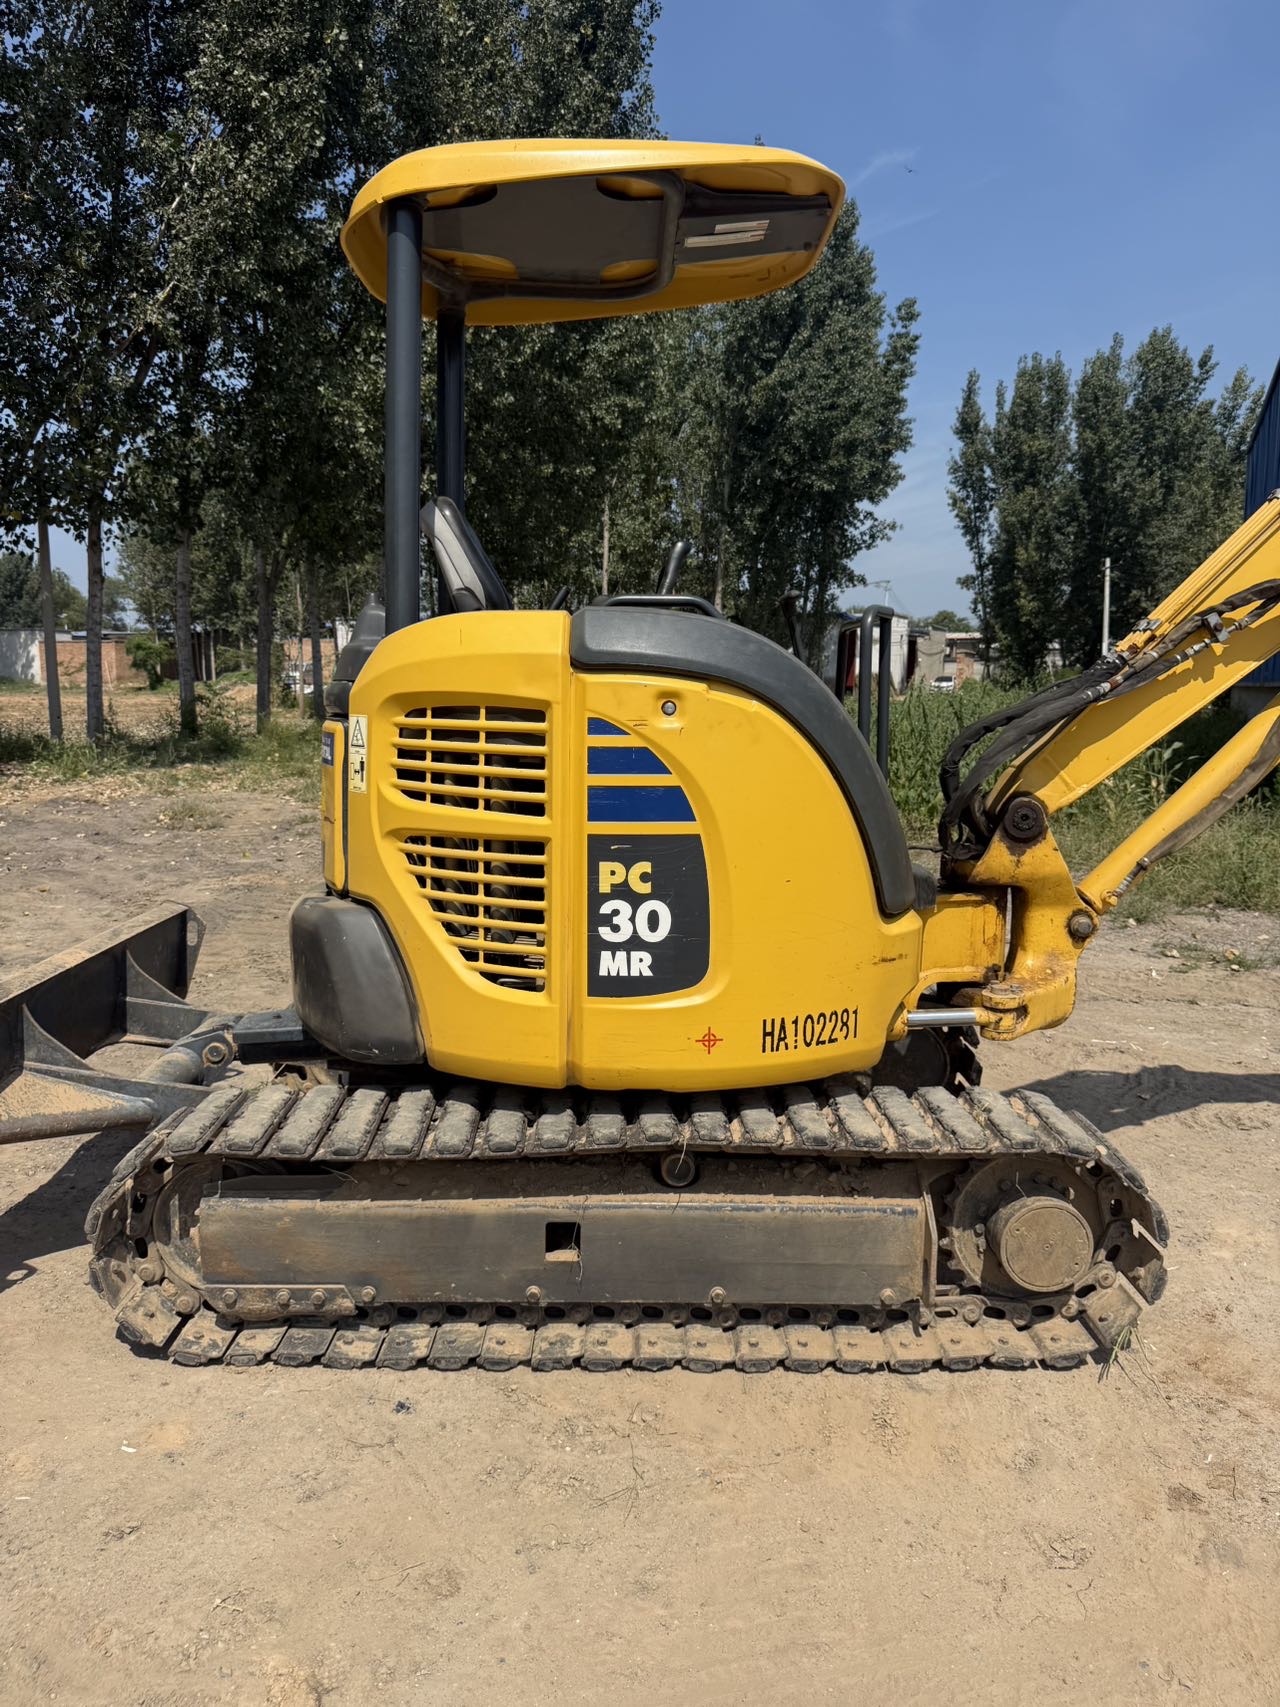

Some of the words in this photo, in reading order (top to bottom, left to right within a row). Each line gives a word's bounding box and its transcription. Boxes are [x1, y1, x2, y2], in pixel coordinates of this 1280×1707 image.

[599, 861, 652, 894] PC
[598, 899, 672, 943] 30
[599, 950, 653, 976] MR
[762, 1005, 859, 1053] HA102281
